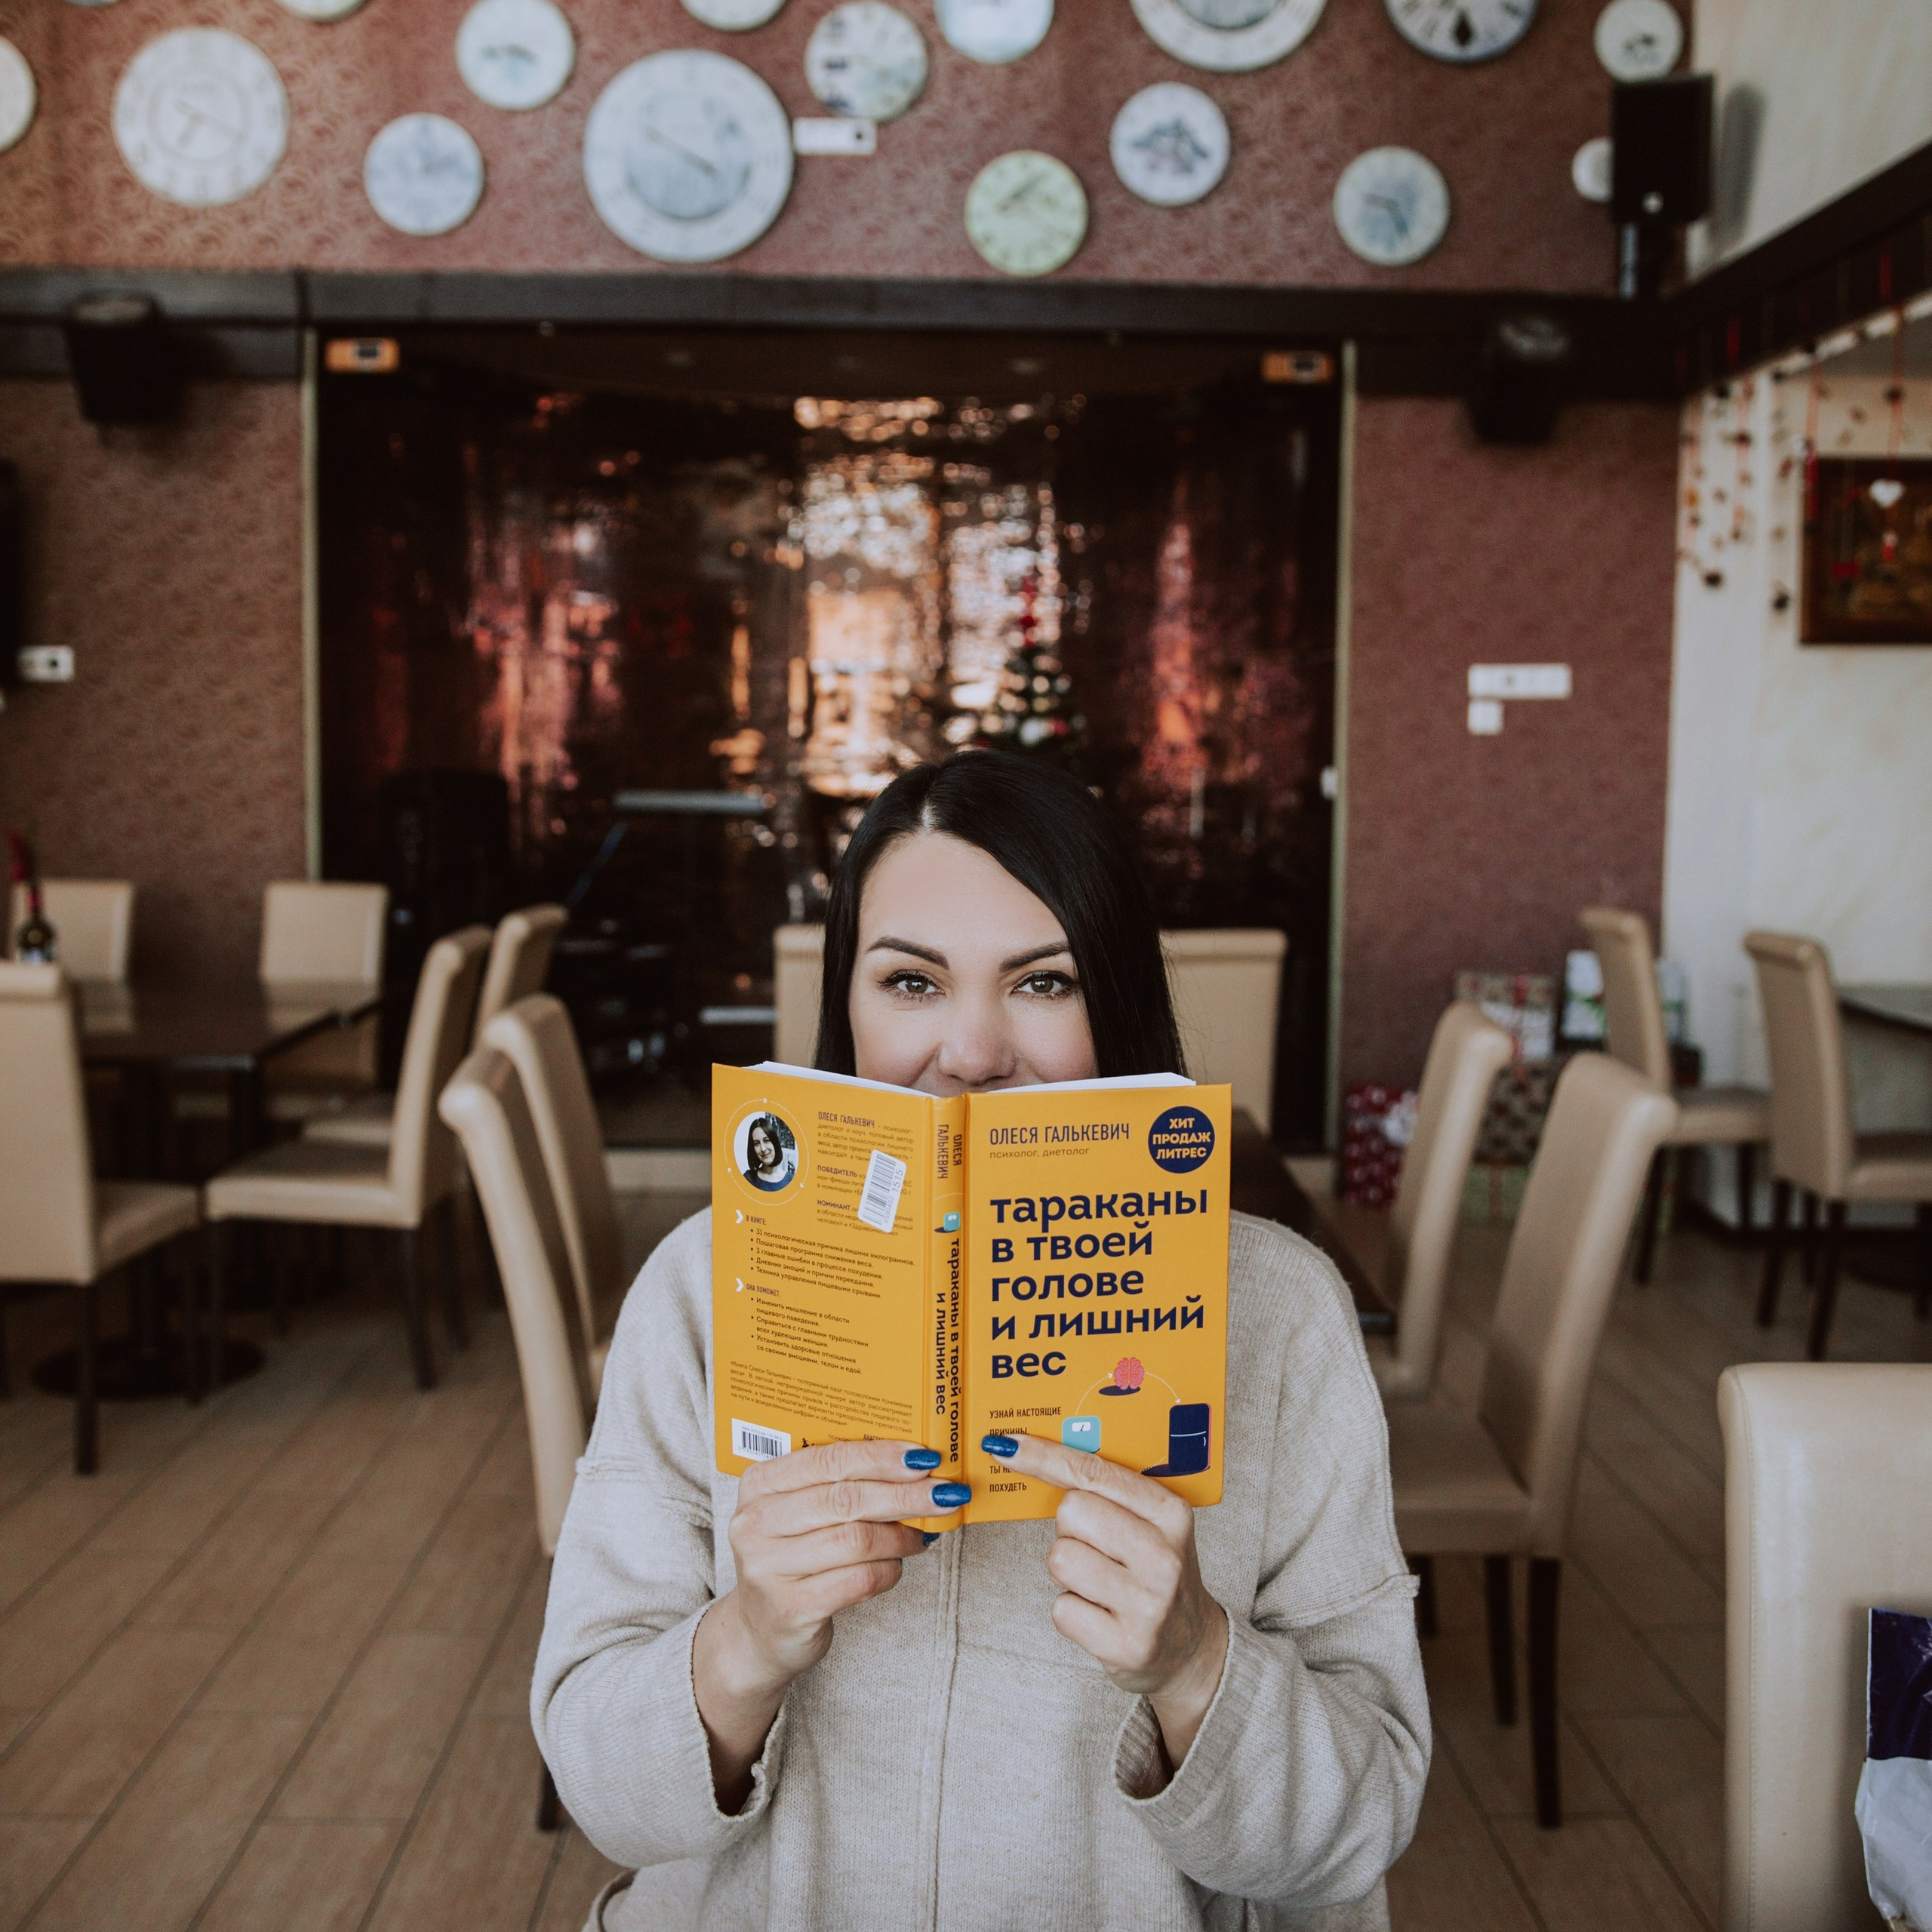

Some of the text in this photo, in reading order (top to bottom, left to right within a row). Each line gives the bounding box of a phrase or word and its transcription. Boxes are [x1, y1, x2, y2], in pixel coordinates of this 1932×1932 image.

[818, 1111, 838, 1122] ОЛЕСЯ
[840, 1115, 875, 1128] ГАЛЬКЕВИЧ
[1169, 1118, 1195, 1130] ХИТ
[989, 1122, 1131, 1146] ОЛЕСЯ ГАЛЬКЕВИЧ
[1152, 1131, 1211, 1146] ПРОДАЖ
[937, 1124, 949, 1180] ГАЛЬКЕВИЧ
[952, 1134, 962, 1166] ОЛЕСЯ
[989, 1146, 1090, 1160] психолог, диетолог
[1155, 1146, 1208, 1161] ЛИТРЕС
[817, 1164, 857, 1177] ПОБЕДИТЕЛЬ
[891, 1168, 904, 1192] 1515
[817, 1199, 851, 1210] НОМИНАНТ
[989, 1189, 1208, 1233] тараканы
[750, 1216, 767, 1225] КНИГЕ:
[756, 1238, 789, 1251] Пошаговая
[790, 1247, 823, 1257] программа
[824, 1254, 856, 1264] снижения
[764, 1232, 816, 1246] психологическая
[817, 1242, 843, 1252] причина
[844, 1248, 869, 1257] лишних
[870, 1254, 915, 1266] килограммов.
[991, 1221, 1153, 1263] в твоей
[756, 1257, 782, 1268] Дневник
[783, 1264, 805, 1272] эмоций
[811, 1270, 834, 1279] причин
[835, 1275, 874, 1287] переедания.
[761, 1250, 786, 1260] главные
[786, 1256, 811, 1264] ошибки
[817, 1262, 847, 1272] процессе
[848, 1268, 883, 1278] похудения.
[756, 1266, 881, 1298] Техника управления пищевыми срывами.
[756, 1285, 780, 1297] ПОМОЖЕТ:
[991, 1270, 1144, 1301] голове
[756, 1297, 785, 1309] Изменить
[786, 1306, 818, 1317] мышление
[823, 1313, 850, 1323] области
[756, 1308, 820, 1326] пищевого поведения.
[991, 1295, 1204, 1340] и лишний
[756, 1316, 792, 1329] Справиться
[798, 1327, 827, 1337] главными
[829, 1334, 869, 1346] трудностями
[771, 1331, 801, 1340] худеющих
[802, 1338, 829, 1347] женщин.
[756, 1334, 857, 1363] Установить здоровые отношения
[935, 1292, 949, 1414] и лишний вес
[947, 1238, 961, 1462] тараканы в твоей голове
[991, 1351, 1067, 1379] вес
[989, 1405, 1062, 1419] УЗНАЙ НАСТОЯЩИЕ
[989, 1464, 1001, 1475] ТЫ
[989, 1481, 1027, 1494] ПОХУДЕТЬ
